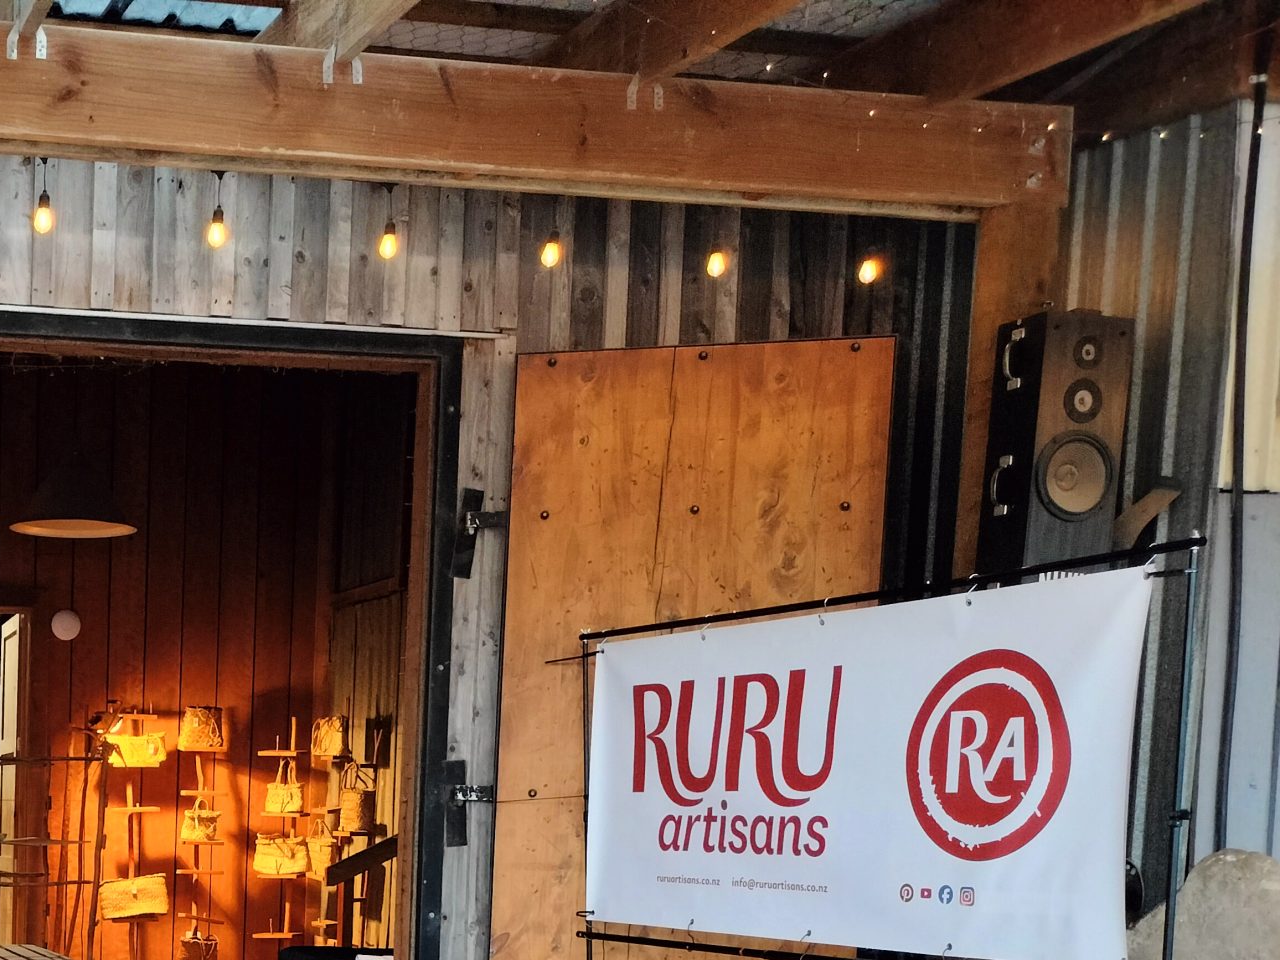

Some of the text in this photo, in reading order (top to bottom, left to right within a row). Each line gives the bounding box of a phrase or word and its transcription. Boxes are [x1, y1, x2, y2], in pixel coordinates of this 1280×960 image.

[631, 665, 843, 807] RURU
[944, 709, 1026, 804] RA
[658, 800, 829, 858] artisans
[656, 874, 720, 886] ruruartisans.co.nz
[731, 876, 828, 893] info@ruruartisans.co.nz
